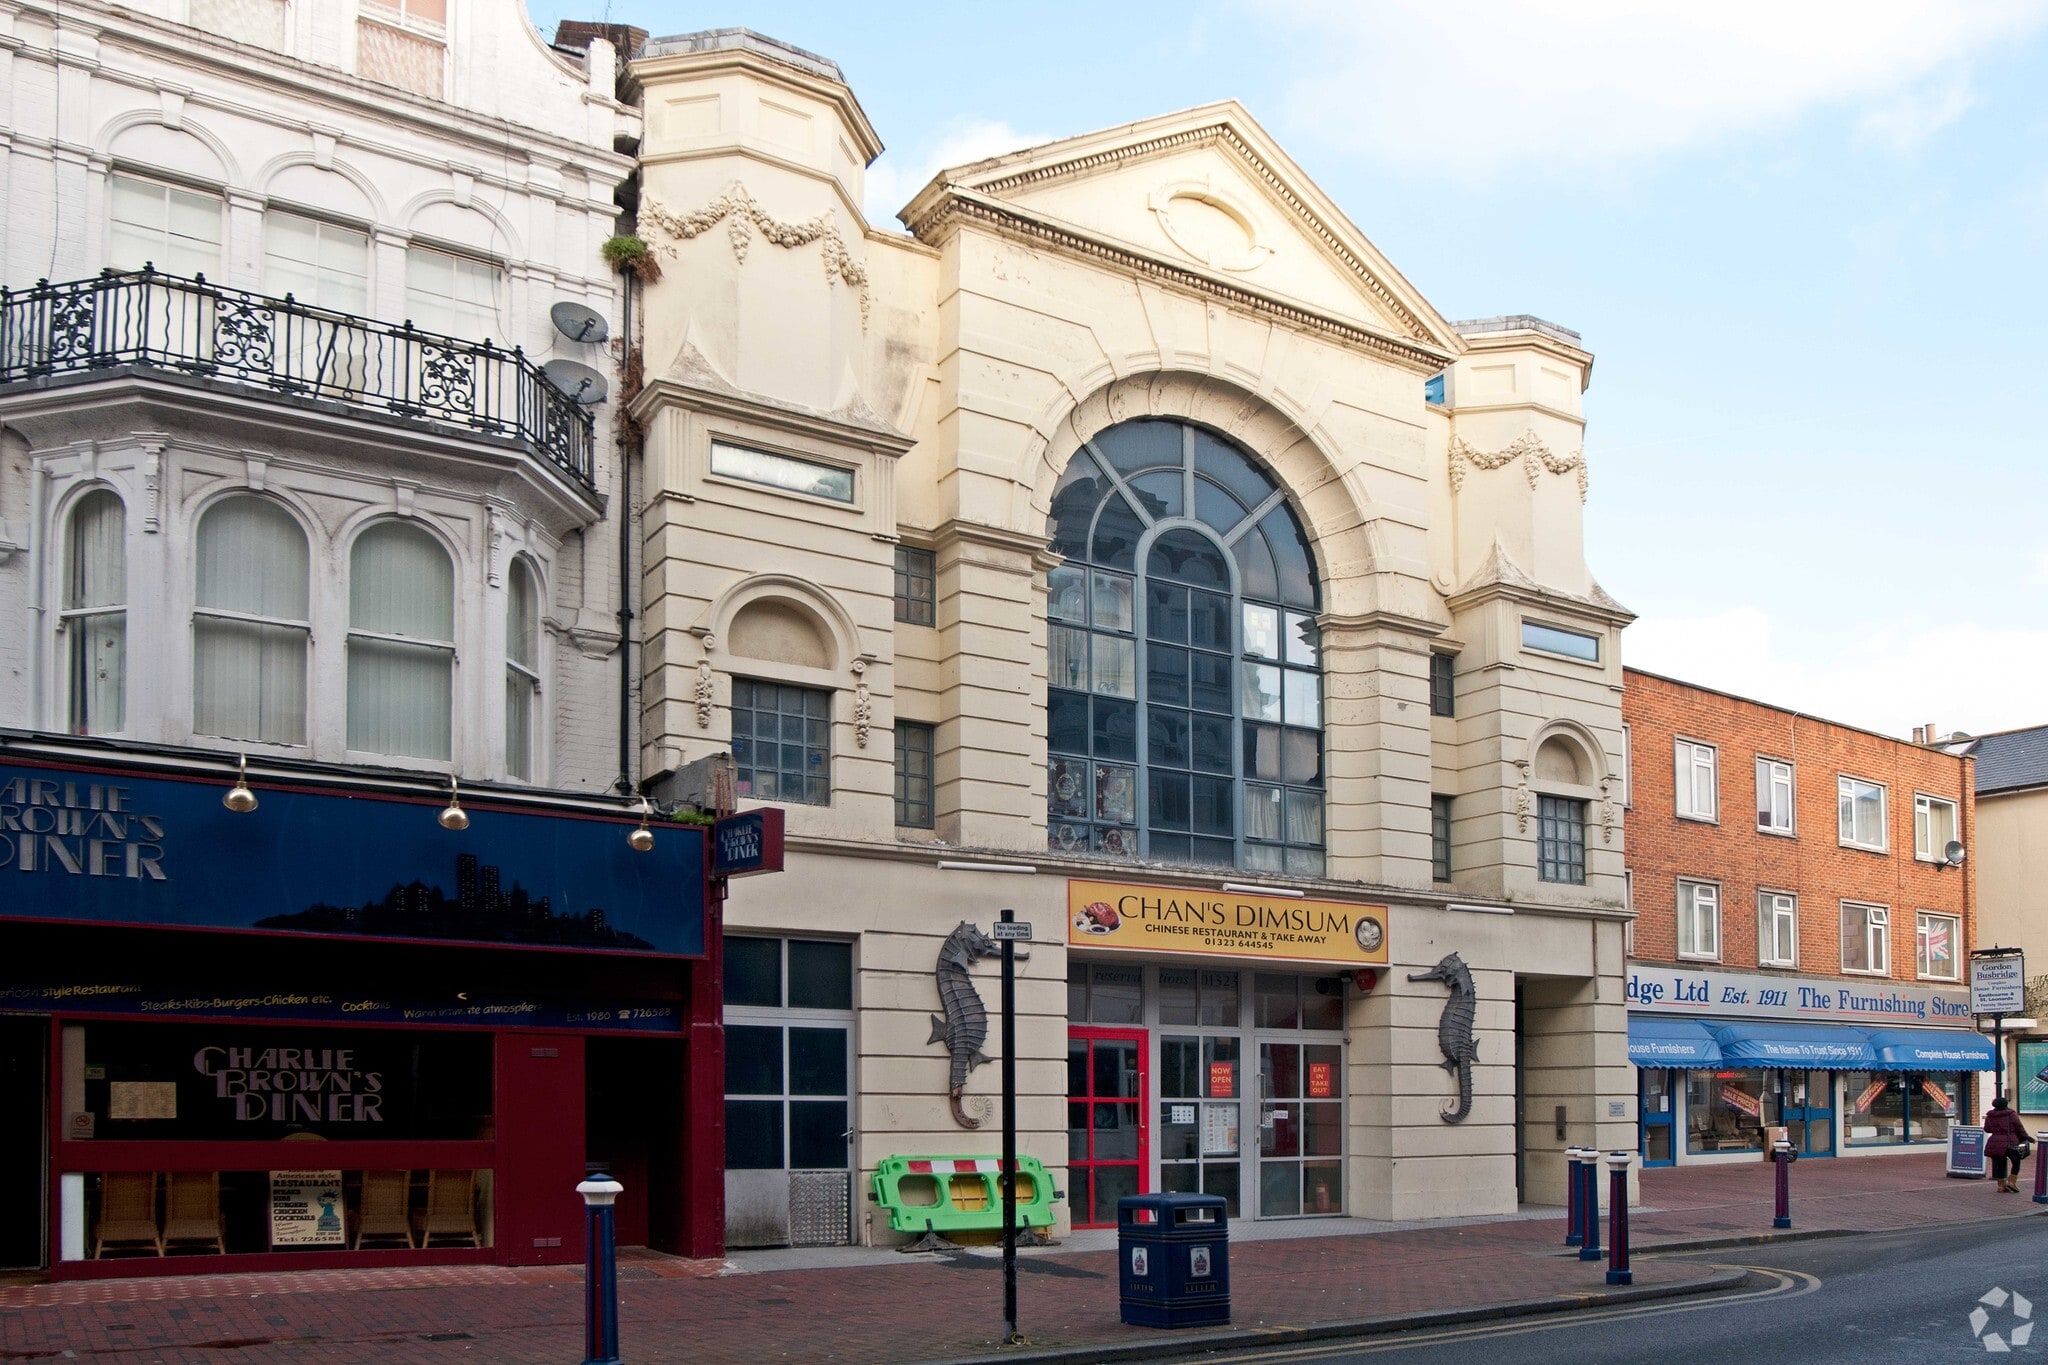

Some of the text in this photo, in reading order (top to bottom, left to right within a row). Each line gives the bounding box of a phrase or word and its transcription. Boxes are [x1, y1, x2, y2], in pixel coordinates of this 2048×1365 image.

[728, 843, 759, 861] DINER
[1118, 895, 1349, 934] CHAN'S DIMSUM
[1145, 924, 1327, 944] CHINESE RESTAURANT & TAKE AWAY
[1204, 938, 1274, 949] 01323 644545
[1976, 970, 2018, 979] Busbridge
[41, 985, 72, 1000] style
[311, 993, 333, 1004] etc.
[1674, 979, 1710, 1002] Ltd
[1720, 987, 1750, 1004] Est.
[1757, 990, 1788, 1007] 1911
[1798, 987, 1831, 1008] The
[1838, 990, 1926, 1019] Furnishing
[1932, 996, 1969, 1017] Store
[341, 999, 391, 1013] Cocktails
[403, 1006, 437, 1018] Warm
[586, 1010, 611, 1021] 1980
[633, 1007, 672, 1019] 726588
[1651, 1043, 1695, 1054] Furnishers
[1764, 1044, 1863, 1056] The Name To Trust Since 1911
[1915, 1049, 1989, 1060] Complete House Furnishers
[193, 1046, 355, 1076] CHARLIE
[1211, 1067, 1231, 1075] NOW
[217, 1069, 383, 1098] BROWN'S
[236, 1092, 384, 1121] DINER
